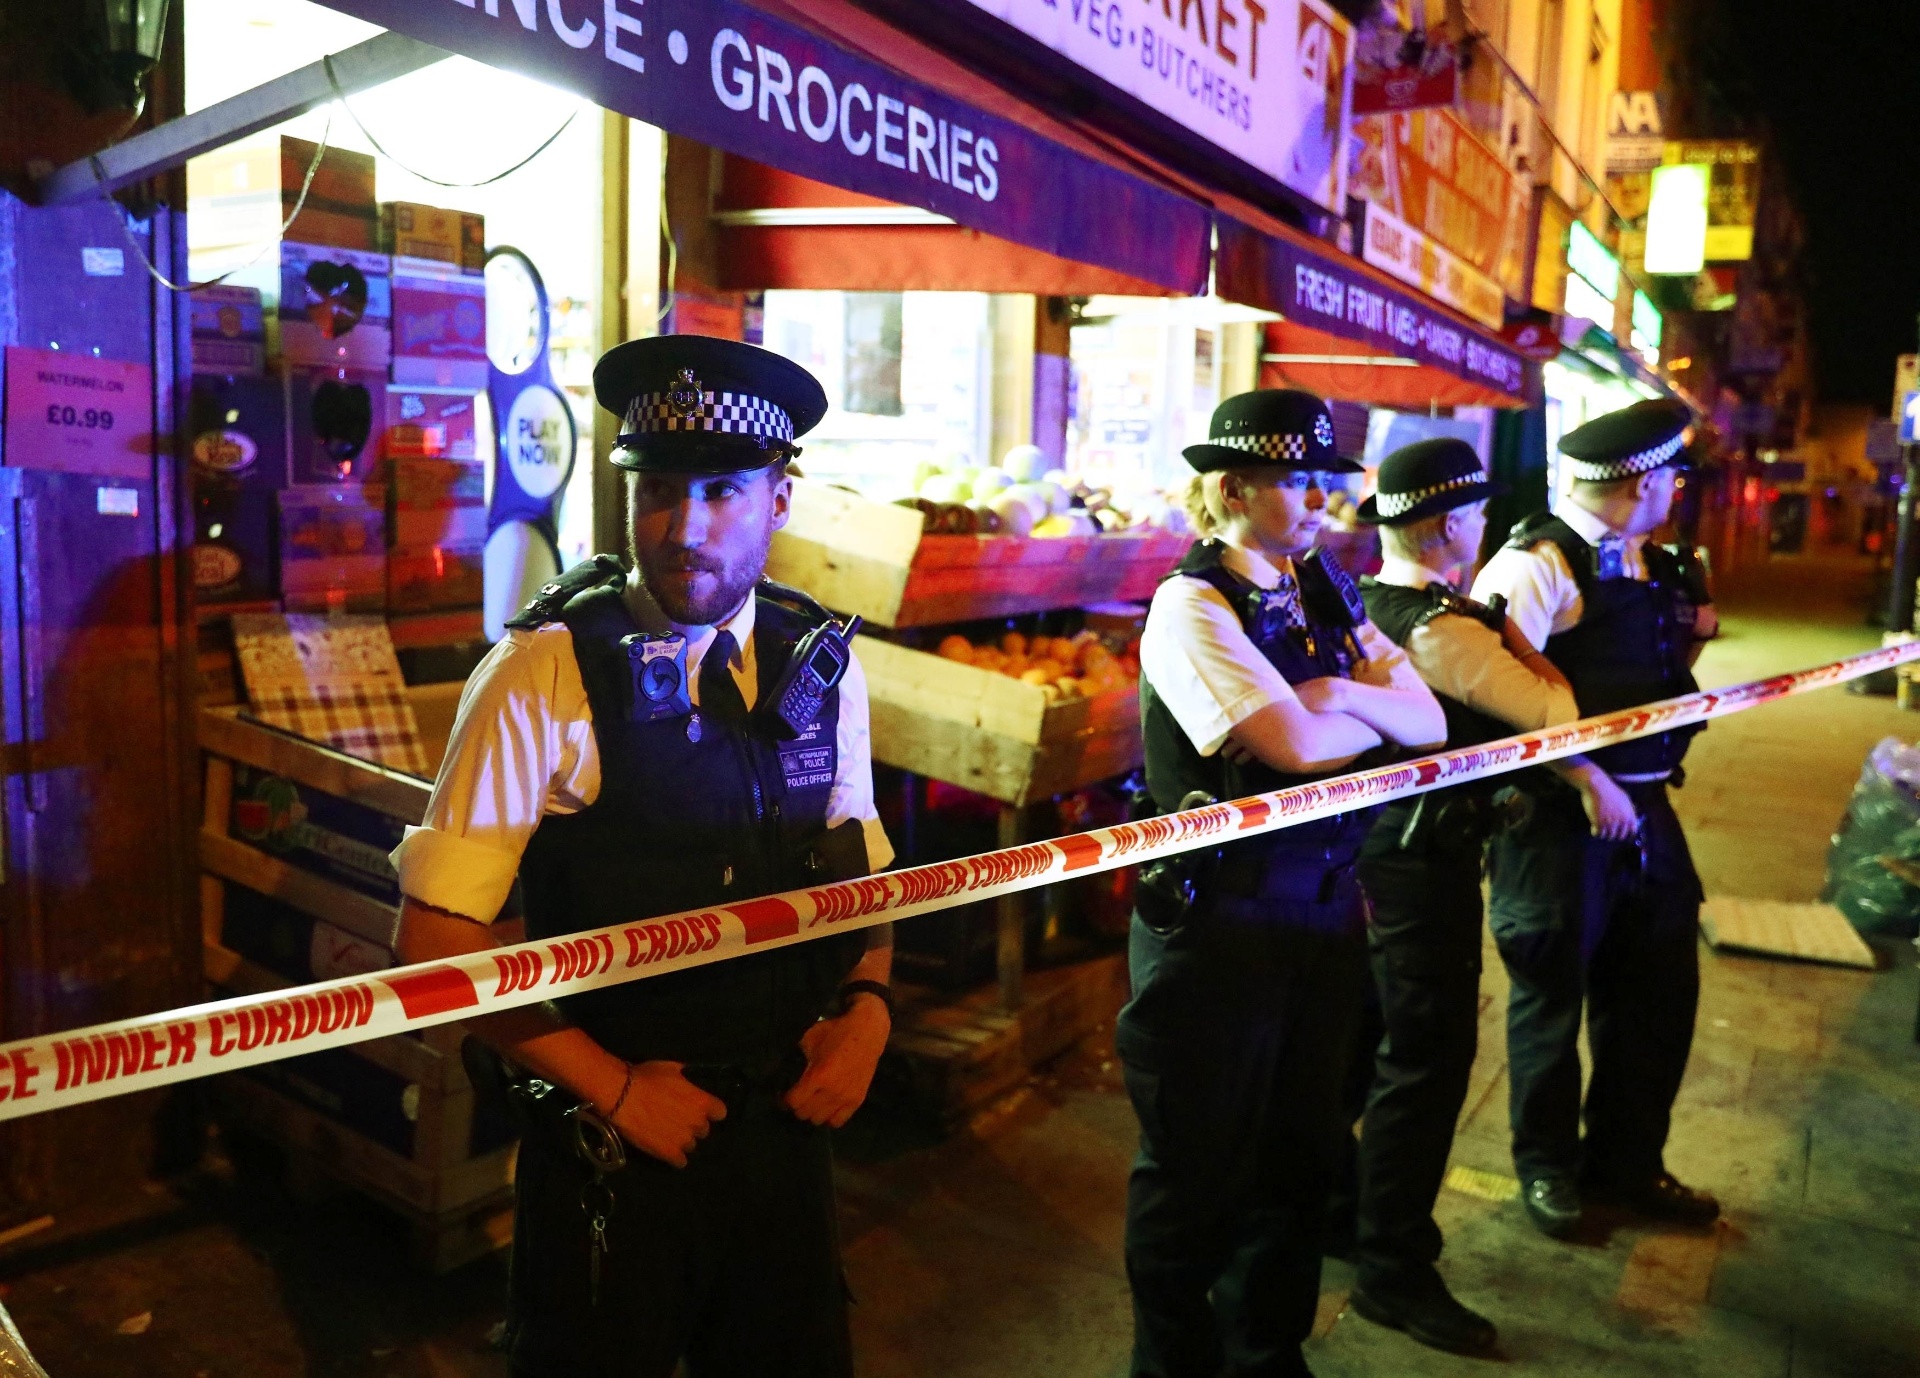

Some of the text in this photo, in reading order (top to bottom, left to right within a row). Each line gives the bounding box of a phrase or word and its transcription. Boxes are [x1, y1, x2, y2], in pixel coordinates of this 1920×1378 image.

[1140, 25, 1251, 131] BUTCHERS
[709, 27, 999, 202] GROCERIES
[1295, 263, 1345, 320] FRESH
[1347, 283, 1385, 334] FRUIT
[37, 370, 124, 393] WATERMELON
[47, 403, 115, 431] £0.99
[519, 417, 562, 441] PLAY
[520, 443, 562, 465] NOW
[803, 757, 826, 768] POLICE
[786, 772, 832, 788] POLICE OFFICER
[54, 1020, 198, 1091] INNER
[209, 981, 374, 1057] CORDON
[492, 949, 542, 997] DO
[547, 933, 614, 986] NOT
[623, 912, 722, 968] CROSS
[807, 876, 895, 928] POLICE
